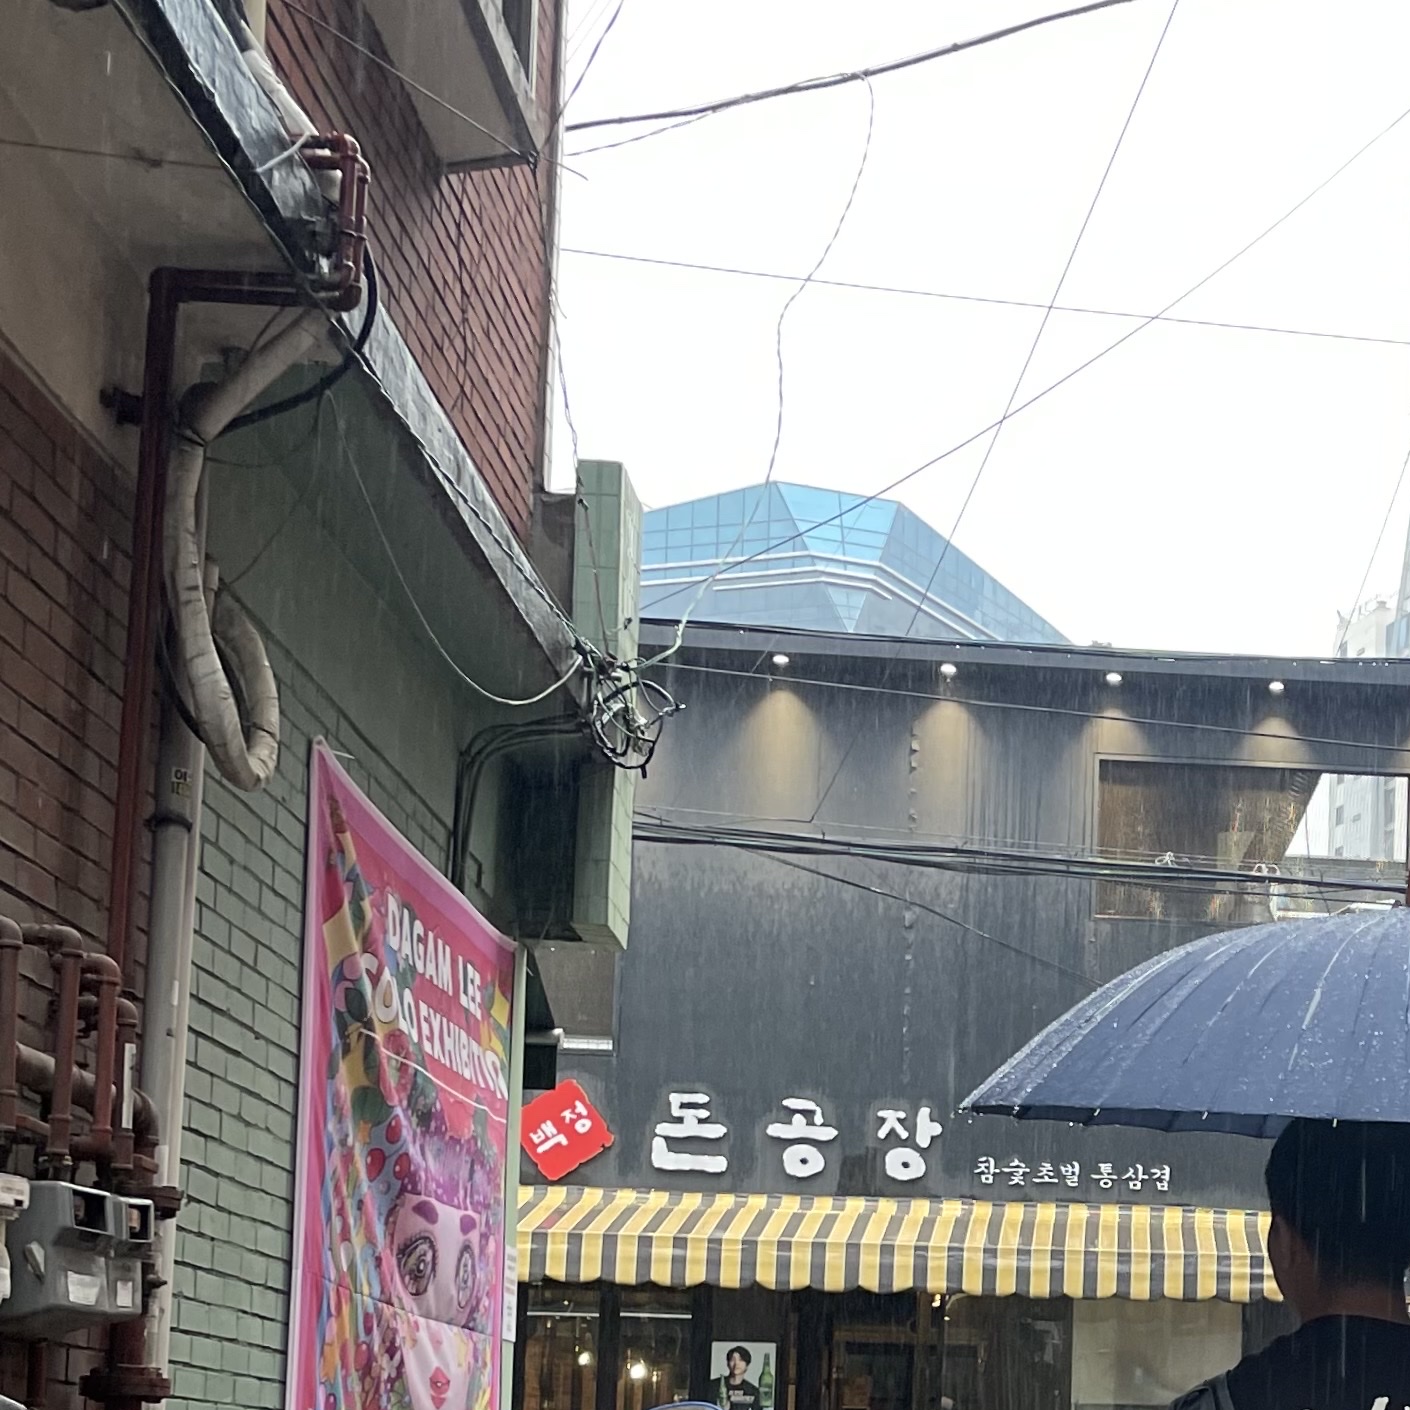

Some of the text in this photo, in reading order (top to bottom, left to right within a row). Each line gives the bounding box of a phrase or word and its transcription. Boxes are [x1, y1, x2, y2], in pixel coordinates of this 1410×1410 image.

[387, 892, 482, 1021] DAGAM LEE
[529, 1099, 593, 1154] 백정
[651, 1092, 943, 1181] 돈공장
[1090, 1162, 1172, 1191] 통삼겹
